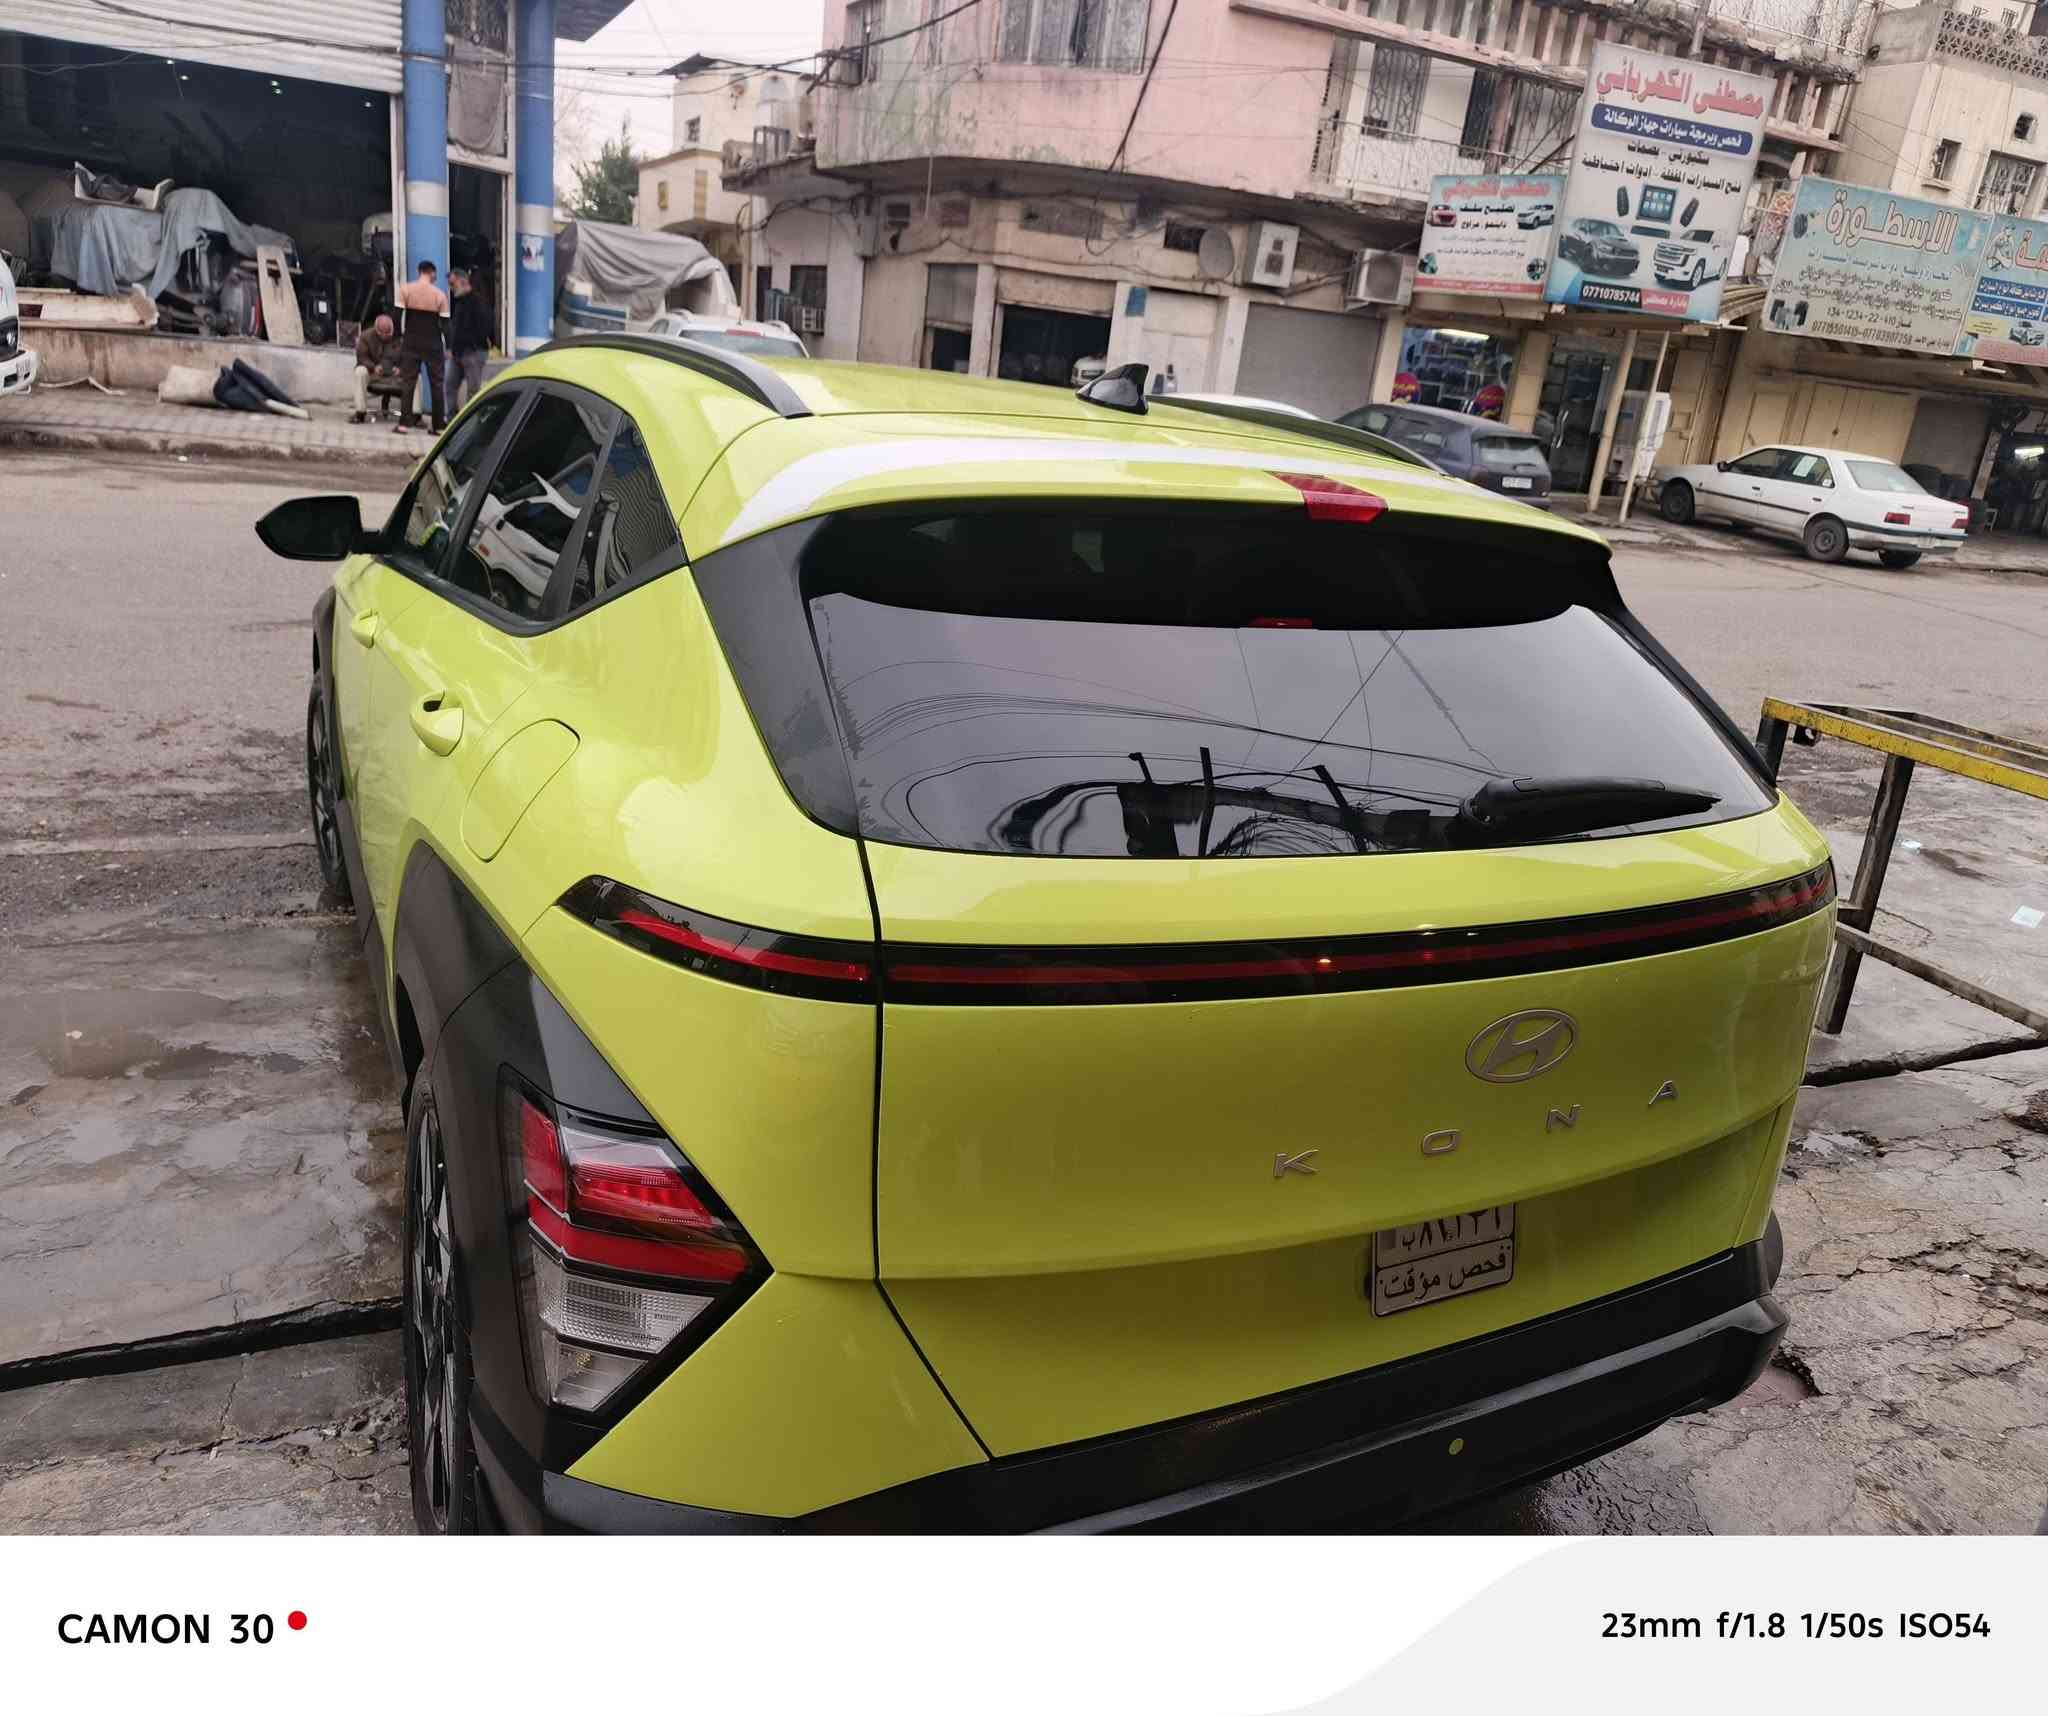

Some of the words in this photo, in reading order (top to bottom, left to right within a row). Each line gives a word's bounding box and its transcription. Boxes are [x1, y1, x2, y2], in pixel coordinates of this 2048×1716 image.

[1693, 79, 1765, 119] مصطفى
[1660, 118, 1687, 139] سيارات
[1826, 188, 1959, 254] الاسطورة
[1273, 1080, 1679, 1178] KONA
[1384, 1267, 1441, 1300] مؤقت
[1449, 1245, 1506, 1290] فحص
